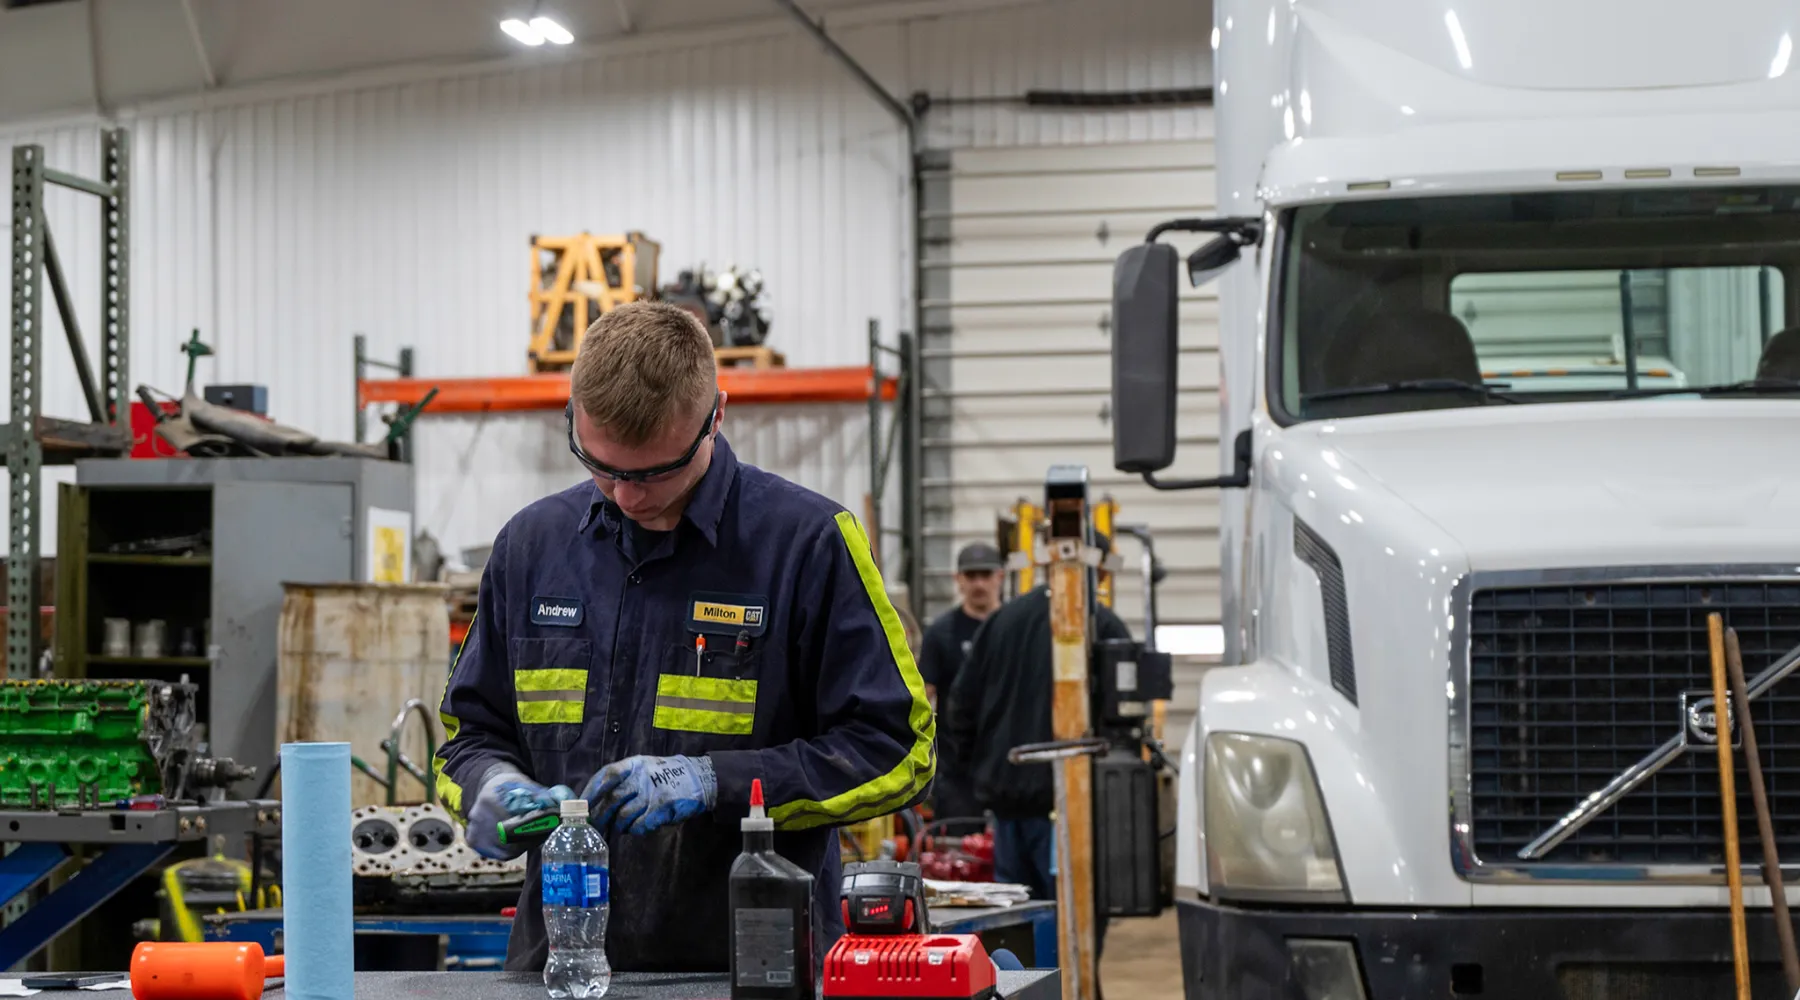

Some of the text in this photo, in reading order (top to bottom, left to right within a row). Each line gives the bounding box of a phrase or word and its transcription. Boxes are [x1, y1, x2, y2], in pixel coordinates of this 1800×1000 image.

[537, 603, 577, 618] Andrew
[703, 606, 760, 621] Milton CAT
[650, 767, 685, 788] HyFlex
